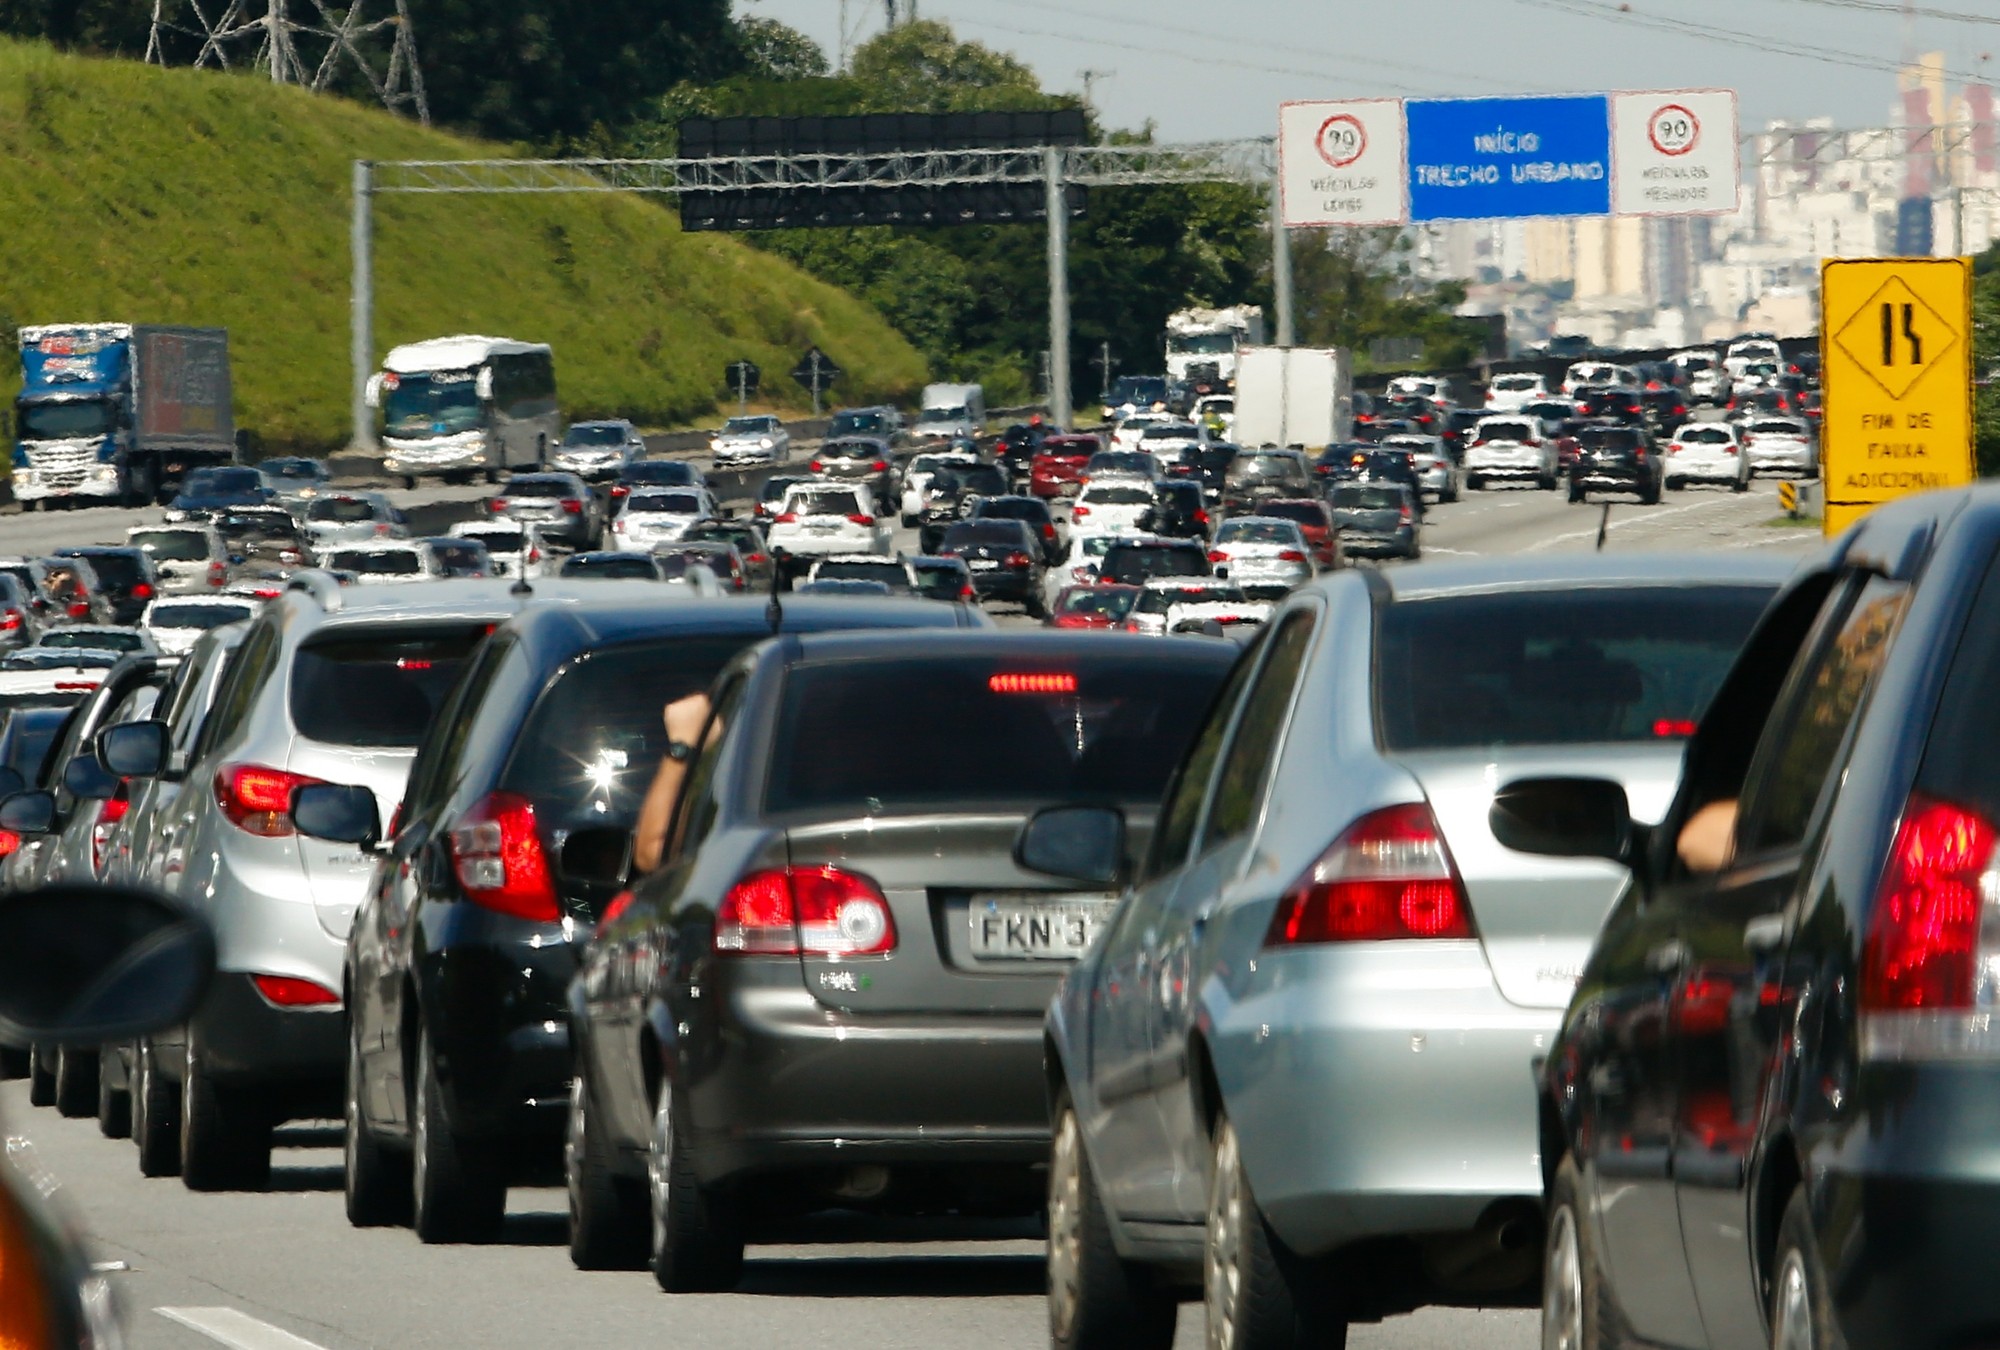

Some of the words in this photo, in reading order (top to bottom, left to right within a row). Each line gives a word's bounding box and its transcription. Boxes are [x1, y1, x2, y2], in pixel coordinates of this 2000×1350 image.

[1661, 119, 1687, 138] 90
[1329, 130, 1355, 146] 90
[1474, 124, 1541, 154] INÍCIO
[1415, 163, 1500, 187] TRECHO
[1511, 160, 1604, 184] URBANO
[1862, 413, 1894, 430] FIM
[1906, 412, 1934, 429] DE
[1867, 443, 1929, 459] FAIXA
